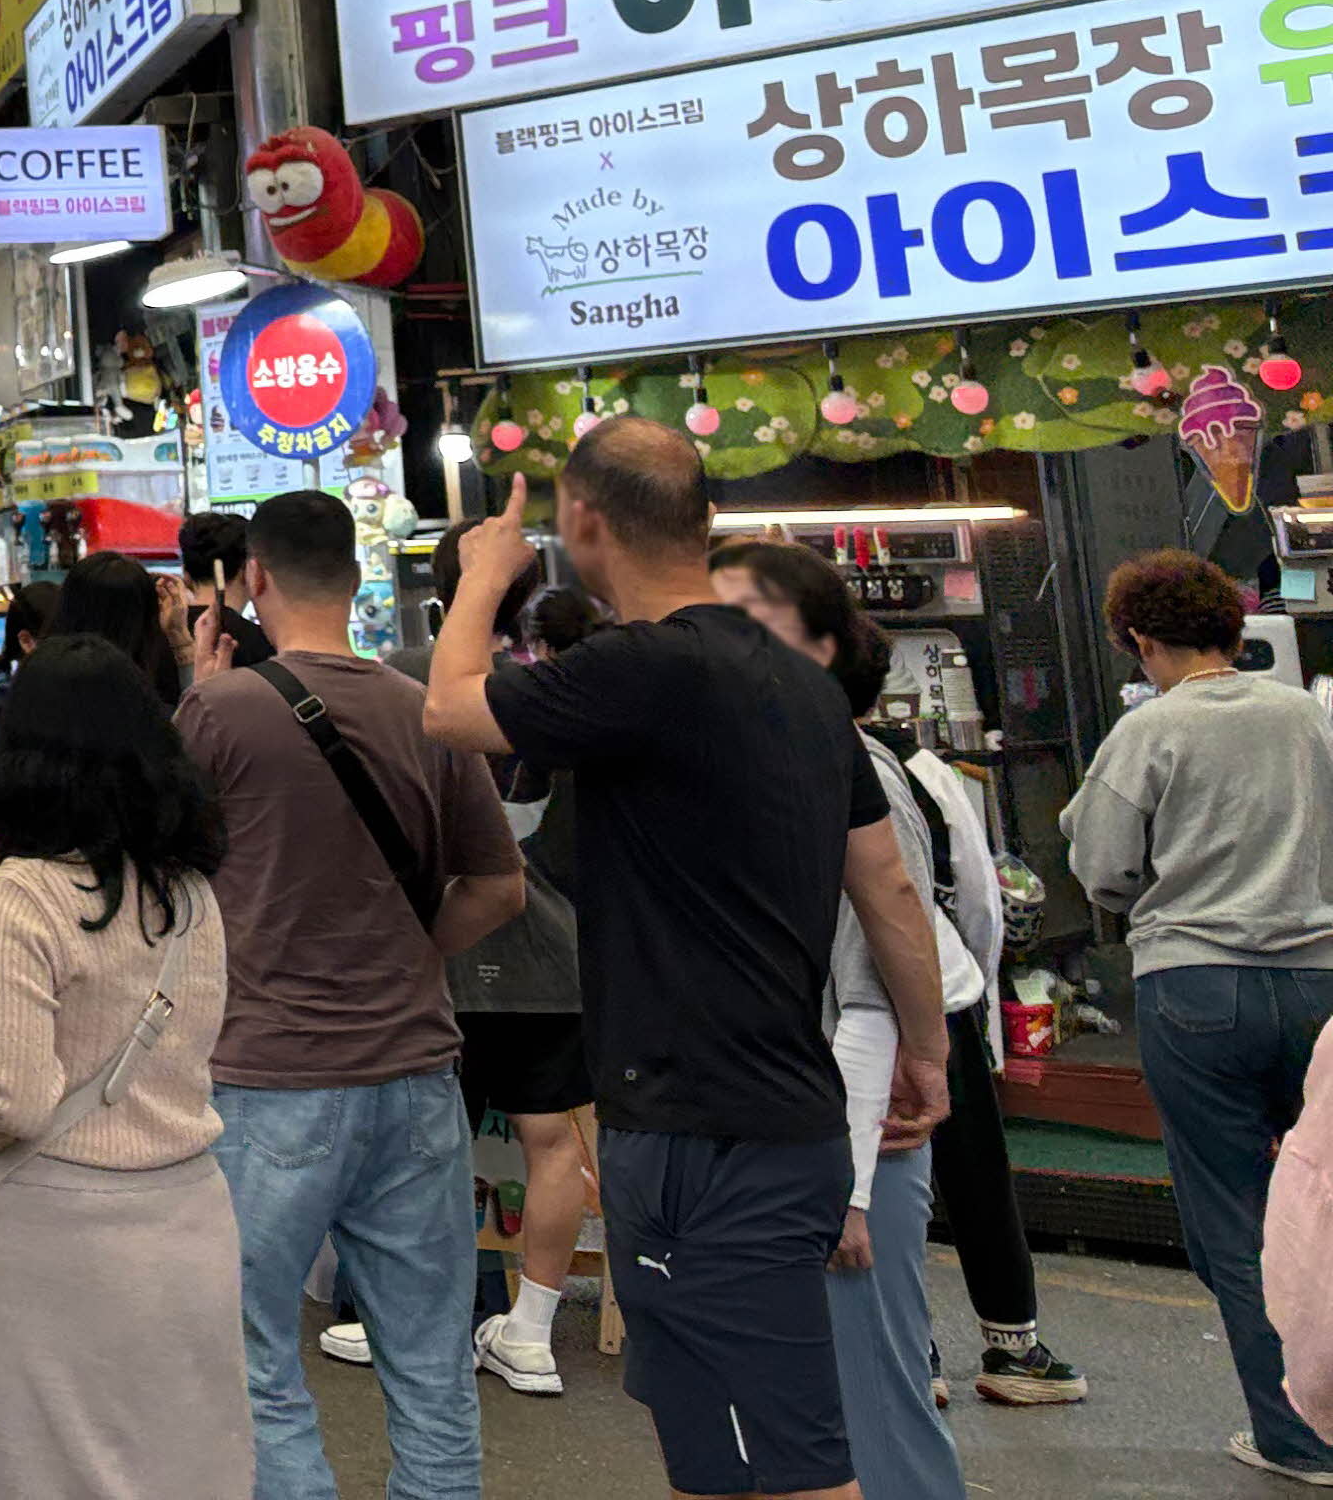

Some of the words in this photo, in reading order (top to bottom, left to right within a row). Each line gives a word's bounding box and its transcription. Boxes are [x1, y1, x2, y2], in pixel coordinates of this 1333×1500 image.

[746, 11, 1221, 182] 상하목장
[495, 120, 583, 155] 블랙핑크
[589, 98, 704, 138] 아이스크림
[66, 194, 146, 215] 아이스크림
[551, 187, 623, 231] Made
[632, 189, 665, 218] by
[594, 226, 709, 274] 상하목장
[570, 294, 680, 328] Sangha
[253, 352, 342, 388] 소방용수
[257, 412, 351, 454] 주정차금지
